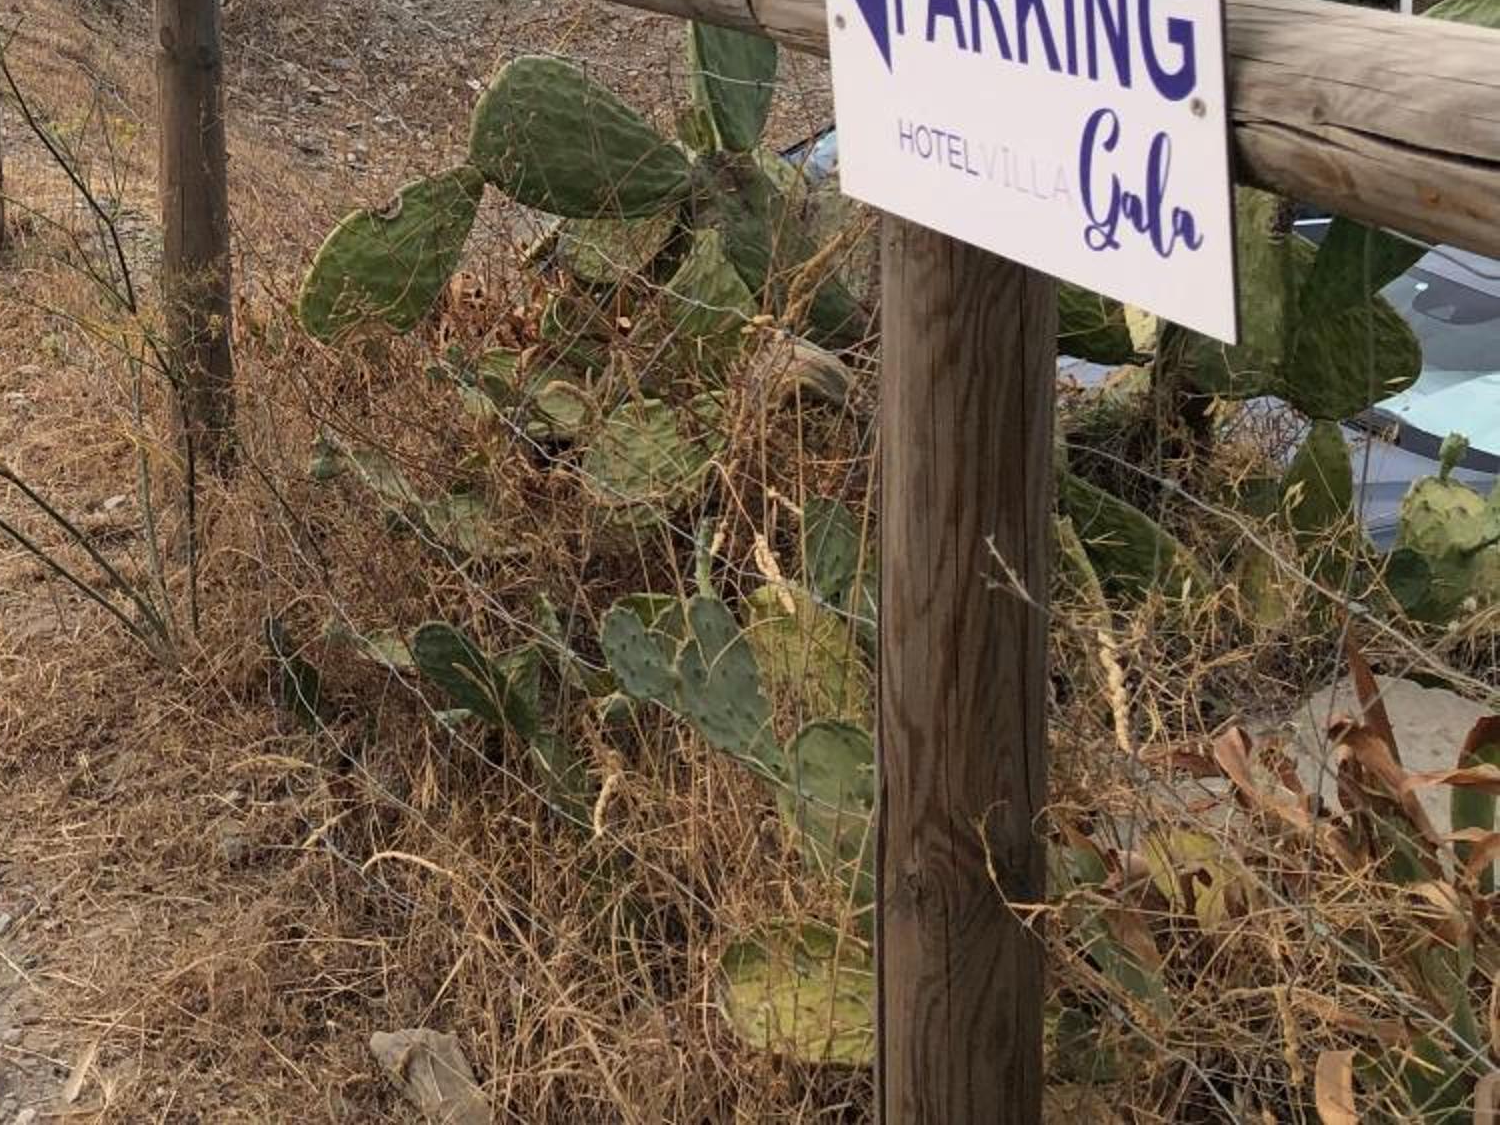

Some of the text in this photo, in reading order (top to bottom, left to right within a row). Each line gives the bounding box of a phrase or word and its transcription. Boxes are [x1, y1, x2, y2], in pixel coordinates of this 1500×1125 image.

[898, 107, 1204, 259] HOTEL VILLA Gala
